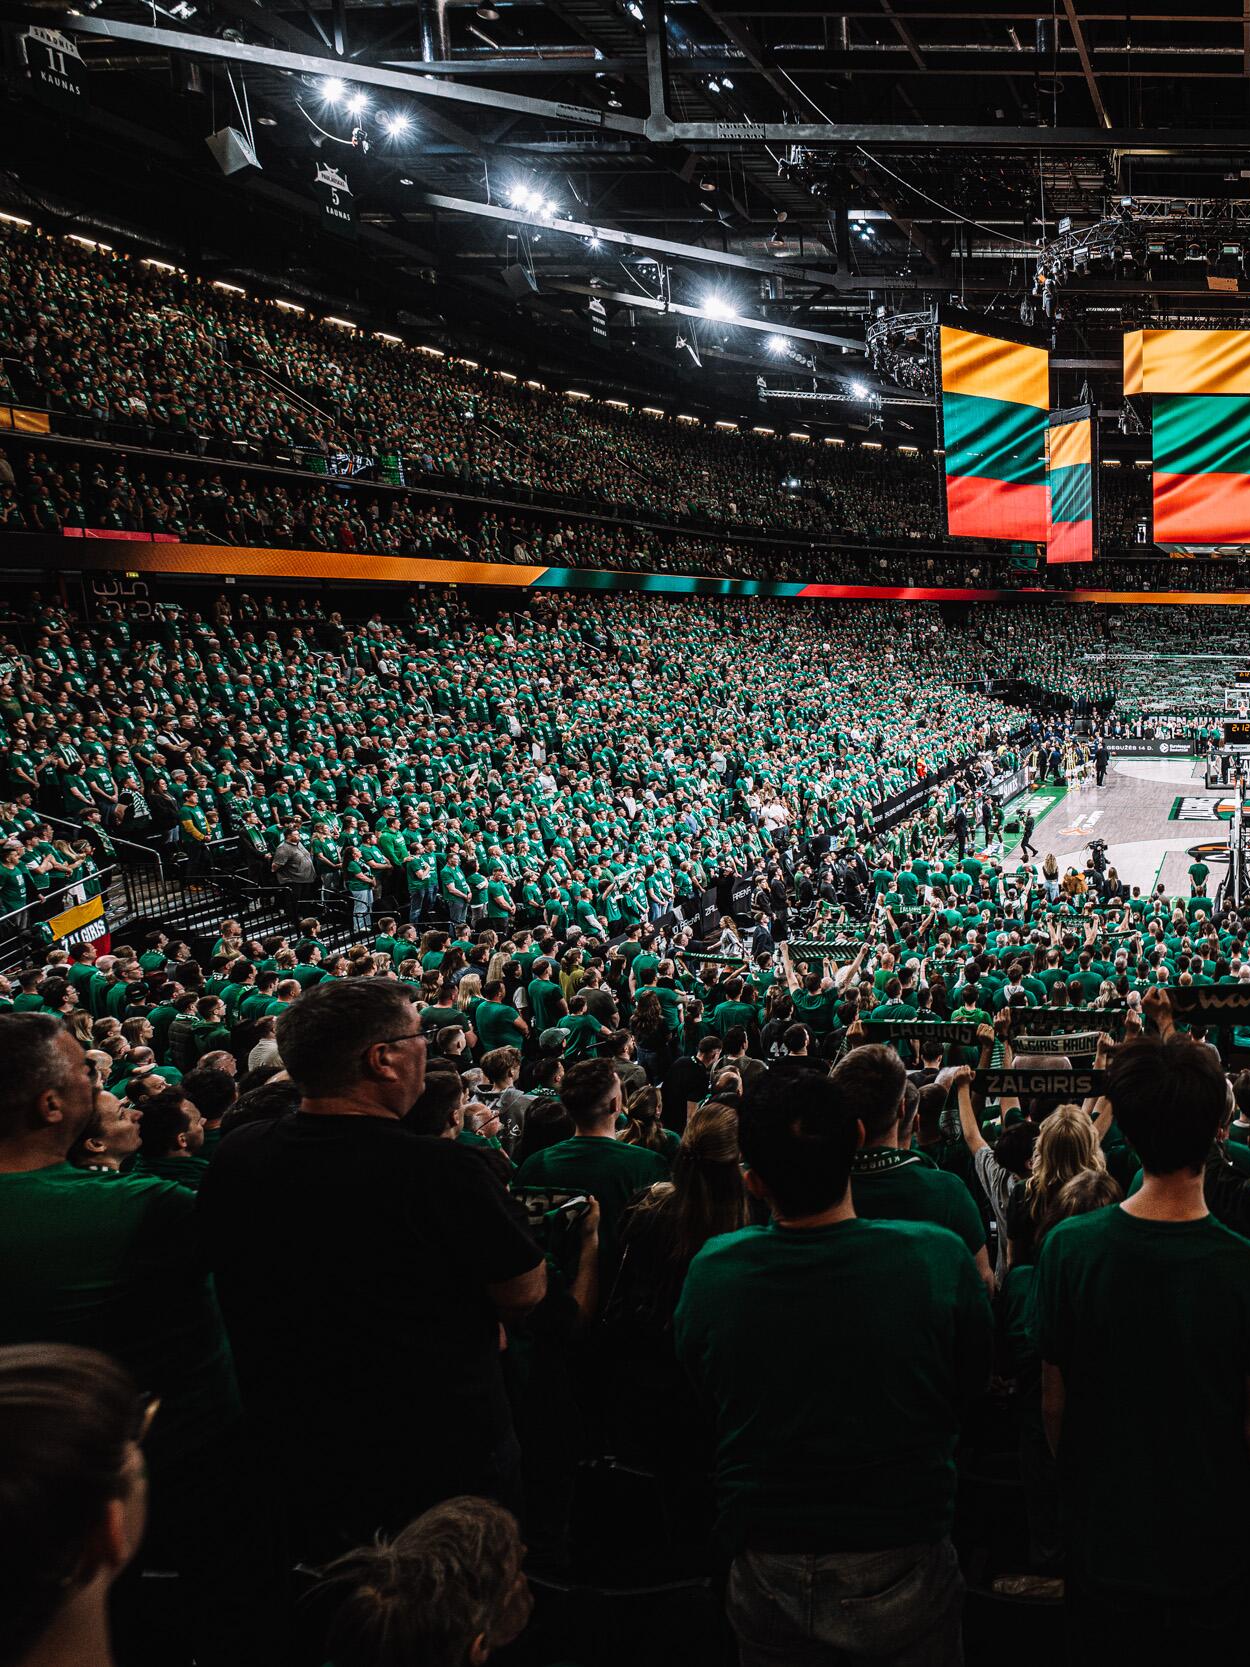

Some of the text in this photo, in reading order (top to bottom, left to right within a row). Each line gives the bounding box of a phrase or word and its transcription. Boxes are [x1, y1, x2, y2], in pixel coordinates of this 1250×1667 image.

[45, 47, 69, 77] 11
[40, 69, 81, 96] KAUNAS
[331, 186, 340, 206] 5
